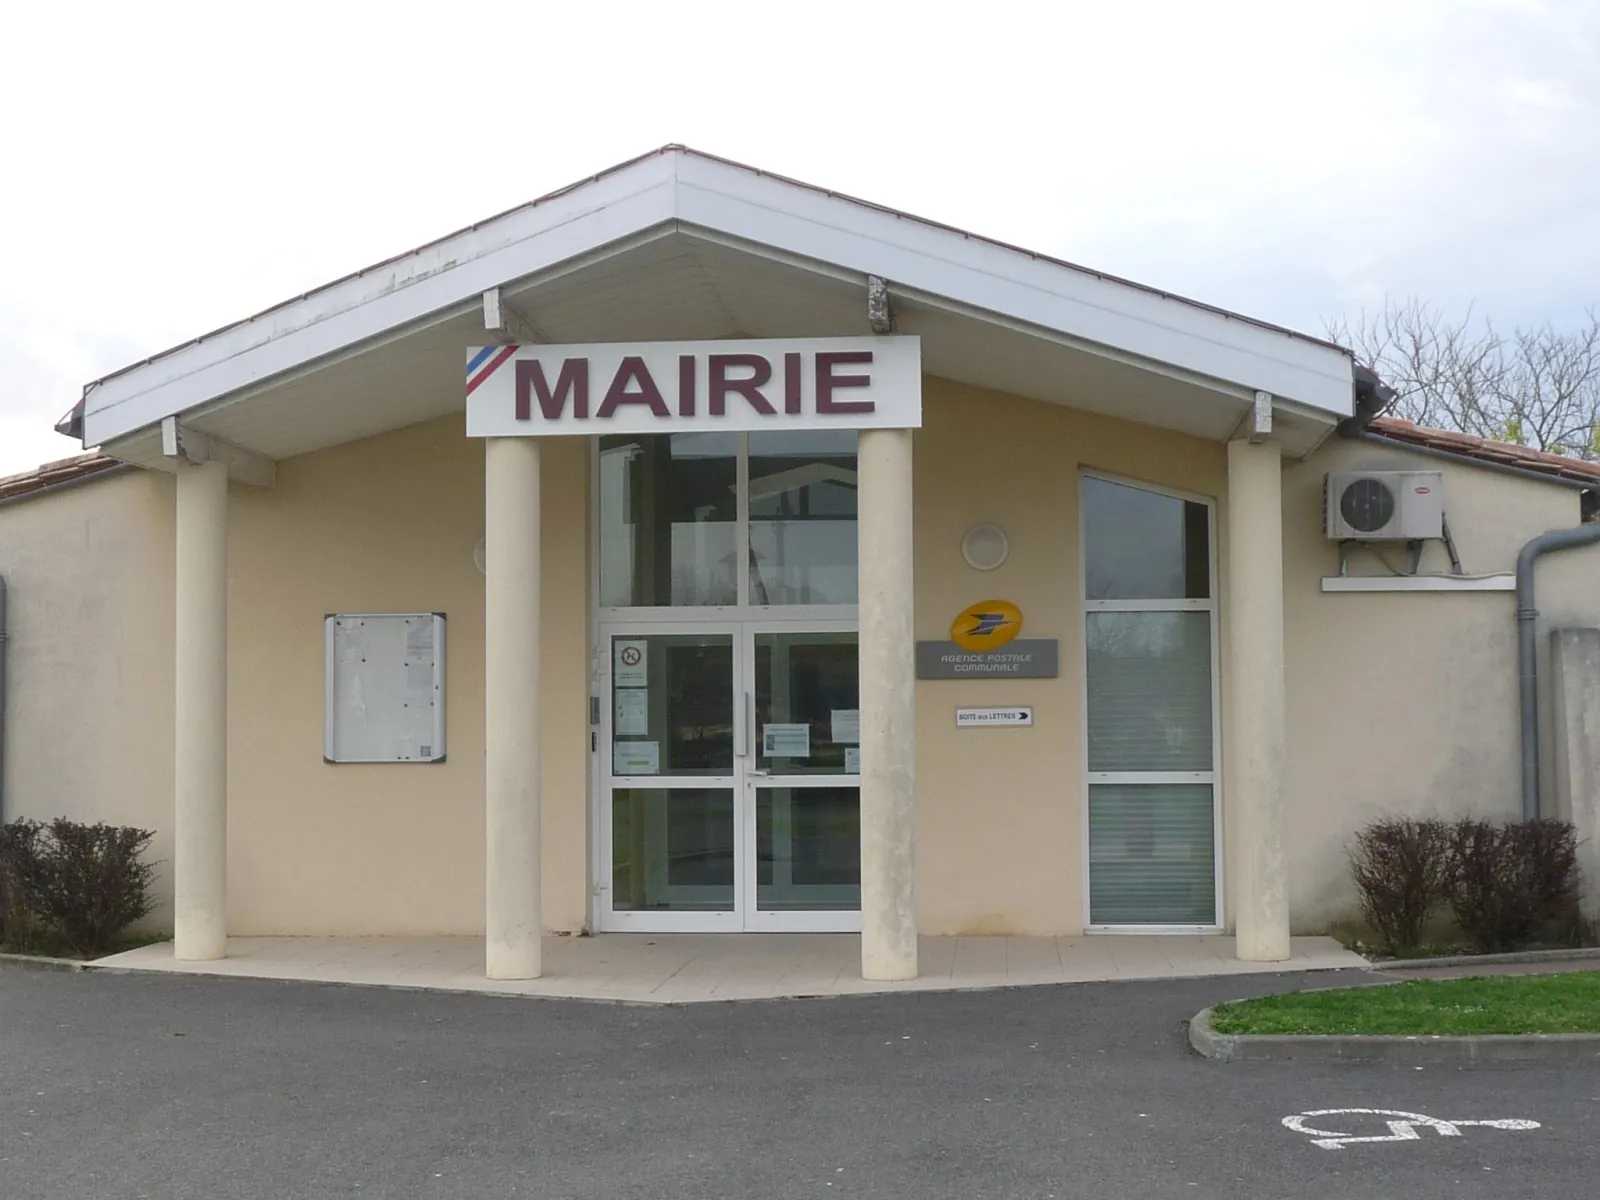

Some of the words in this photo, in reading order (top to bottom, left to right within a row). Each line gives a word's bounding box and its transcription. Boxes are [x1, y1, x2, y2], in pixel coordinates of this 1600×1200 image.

[515, 351, 876, 420] MAIRIE
[941, 654, 984, 662] AGENCE
[987, 654, 1032, 662] POSTALE
[954, 663, 1020, 672] COMMUNALE
[989, 712, 1016, 720] LETTRES
